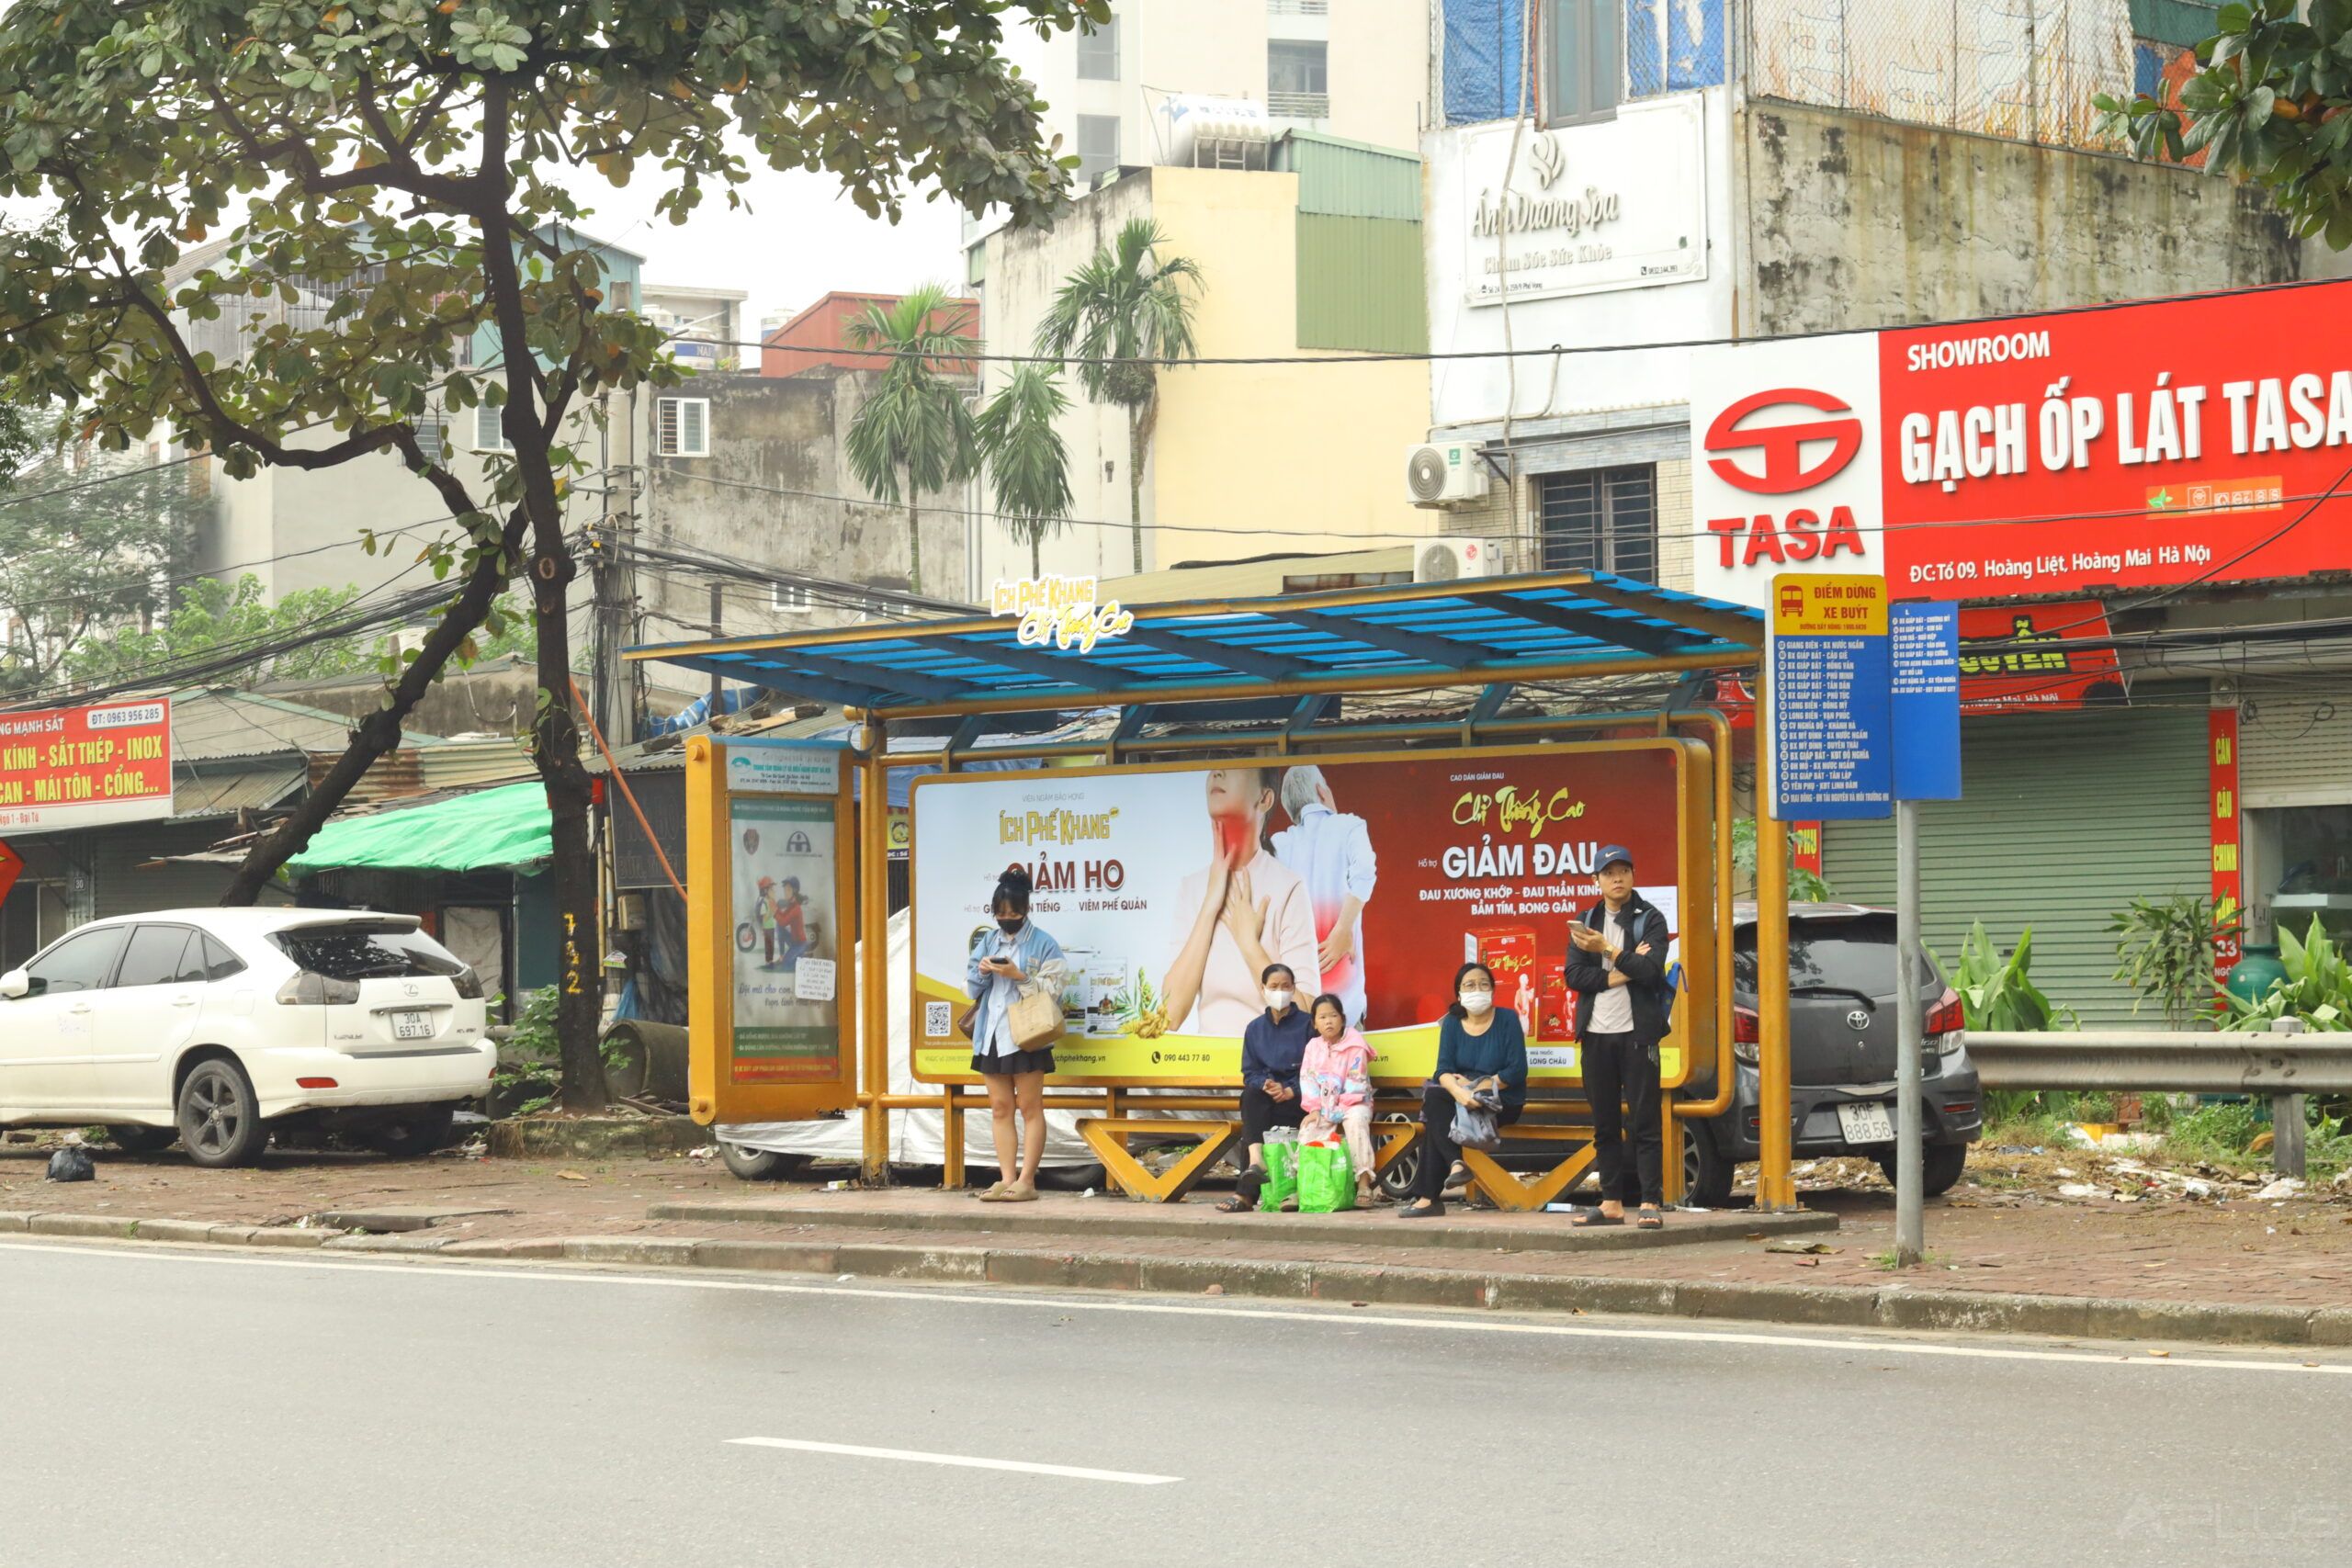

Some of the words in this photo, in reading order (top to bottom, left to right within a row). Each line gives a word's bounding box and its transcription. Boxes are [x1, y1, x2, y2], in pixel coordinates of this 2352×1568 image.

[1581, 187, 1620, 231] Spa
[1485, 256, 1521, 274] Chm
[1907, 331, 2051, 372] SHOWROOM
[1901, 401, 2028, 492] GẠCH
[2040, 376, 2104, 471] ỐP
[2117, 371, 2206, 465] LÁT
[2222, 370, 2352, 455] TASA
[1708, 506, 1865, 568] TASA
[1984, 558, 2032, 579] Hoàng
[2037, 556, 2068, 577] Liệt,
[2073, 553, 2120, 572] Hoàng
[2126, 547, 2151, 567] Mai
[2159, 546, 2179, 564] Hà
[2185, 545, 2211, 566] Nội
[1815, 581, 1842, 599] ĐIỂM
[1846, 583, 1876, 599] DỪNG
[1824, 607, 1838, 618] XE
[1841, 604, 1868, 619] BUÝT
[92, 714, 105, 725] ĐT:
[107, 712, 126, 723] 0963
[129, 710, 142, 721] 956
[145, 708, 159, 719] 285
[14, 720, 43, 737] MẠNH
[4, 743, 37, 771] KÍNH
[49, 735, 75, 767] SẮT
[78, 736, 114, 765] THÉP
[128, 735, 163, 761] INOX
[35, 774, 61, 801] MÁI
[64, 772, 91, 799] TÔN
[1548, 787, 1586, 821] Cao
[1000, 809, 1023, 845] ÍCH
[1026, 808, 1059, 846] PHẾ
[1060, 810, 1110, 845] KHANG
[1442, 834, 1524, 878] GIẢM
[1532, 842, 1598, 875] ĐAU
[75, 879, 85, 889] 30
[1084, 859, 1125, 891] HO
[1419, 889, 1441, 900] ĐAU
[1443, 886, 1481, 899] XƯƠNG
[1484, 884, 1513, 899] KHỚP
[1523, 886, 1544, 898] ĐAU
[1036, 899, 1061, 913] TIẾNG
[1080, 899, 1100, 911] VIÊM
[1102, 897, 1118, 910] PHẾ
[1121, 897, 1148, 910] QUẢN
[1519, 903, 1550, 913] BONG
[1553, 902, 1576, 913] GÂN
[2216, 940, 2237, 957] 23
[404, 1013, 421, 1024] 30A
[400, 1025, 431, 1037] 697.16
[1549, 1056, 1566, 1065] CHÂU
[1849, 1102, 1874, 1121] 30F
[1846, 1122, 1891, 1140] 888.56
